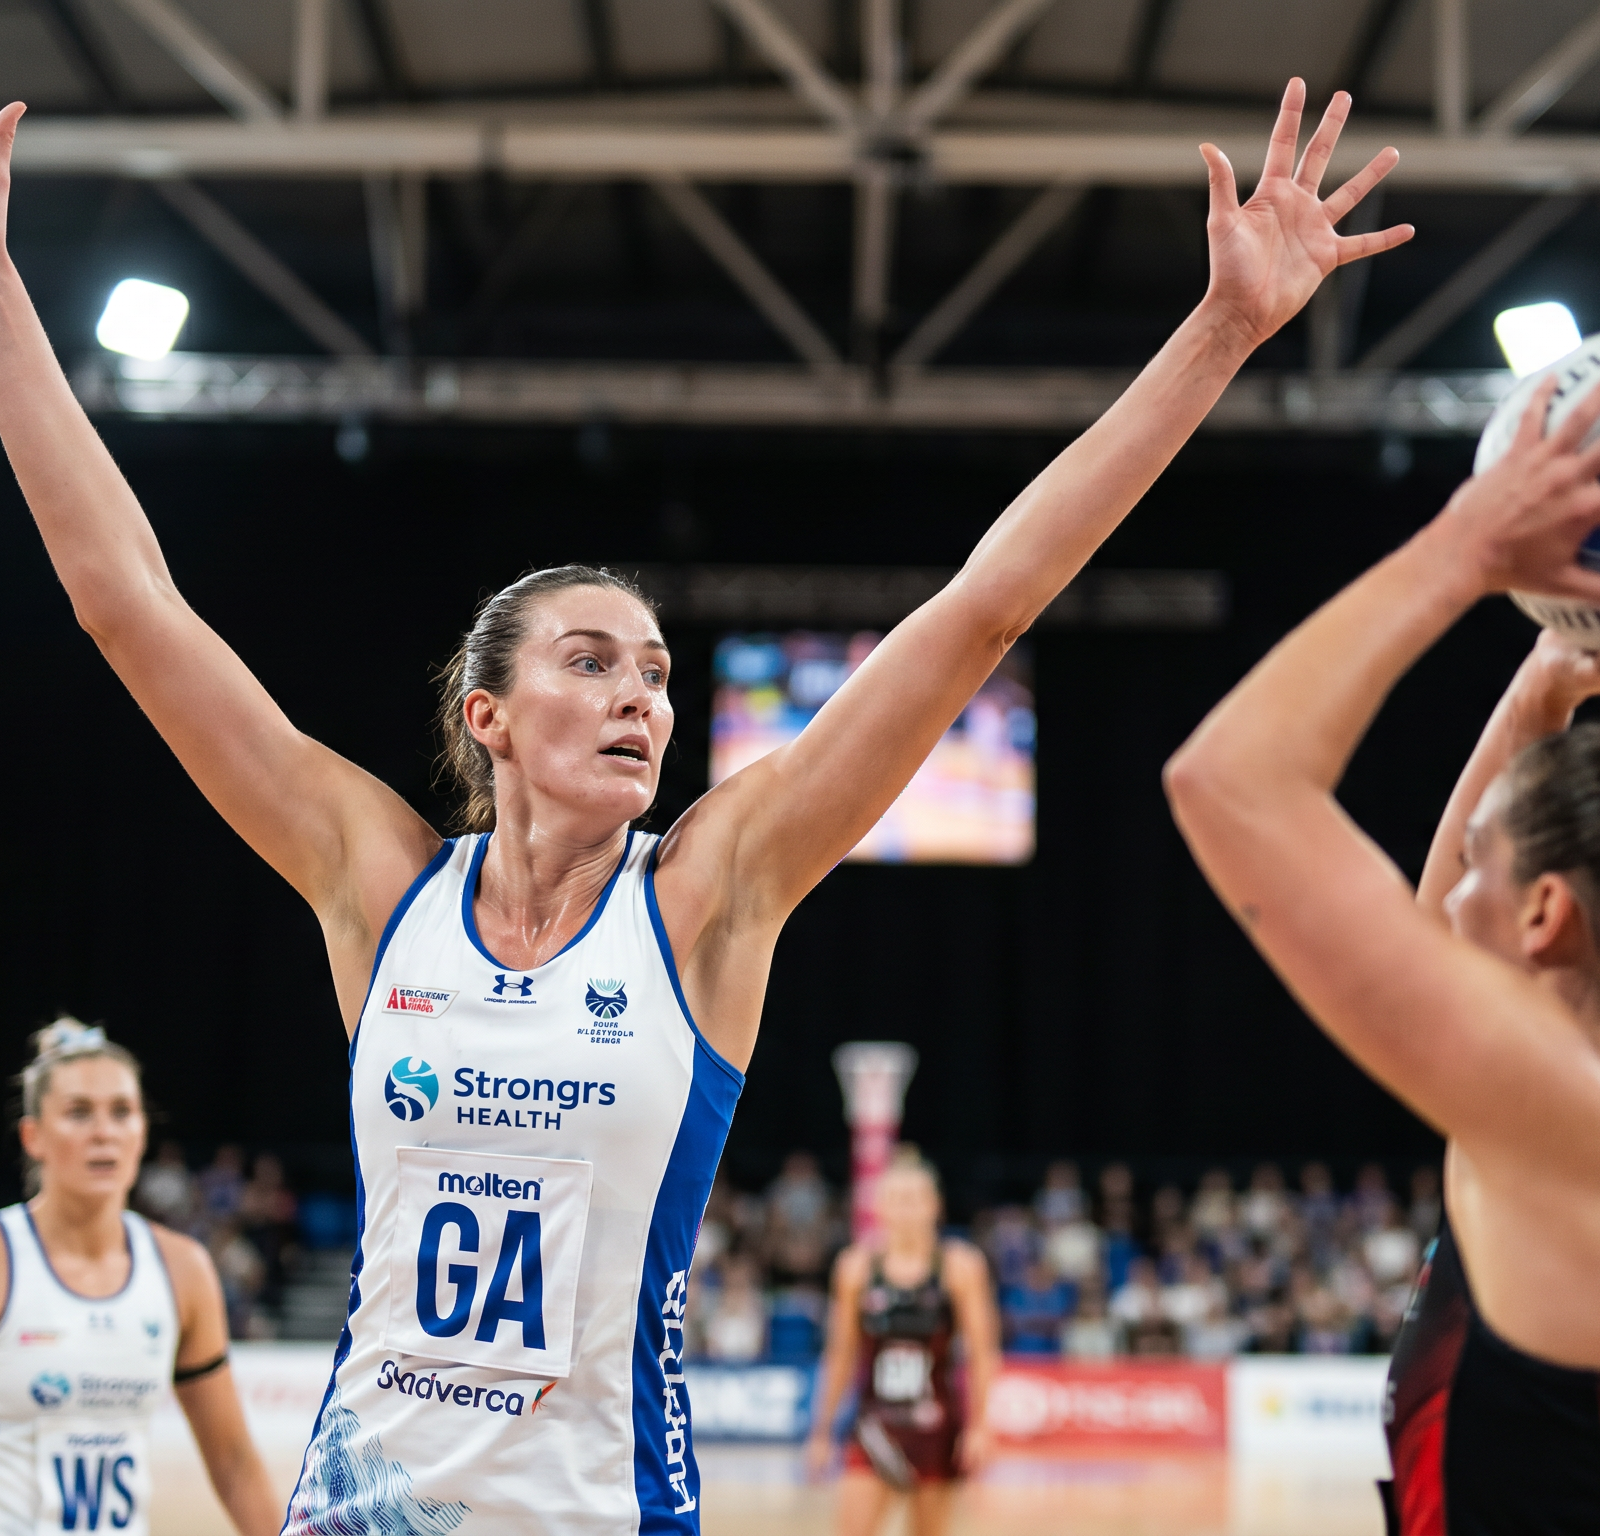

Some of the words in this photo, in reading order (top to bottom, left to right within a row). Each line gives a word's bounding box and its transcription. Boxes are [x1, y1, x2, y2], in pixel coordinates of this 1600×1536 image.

[453, 1067, 616, 1110] Strongrs
[457, 1106, 561, 1131] HEALTH
[438, 1172, 541, 1201] molten
[416, 1202, 546, 1350] GA
[54, 1454, 135, 1532] WS
